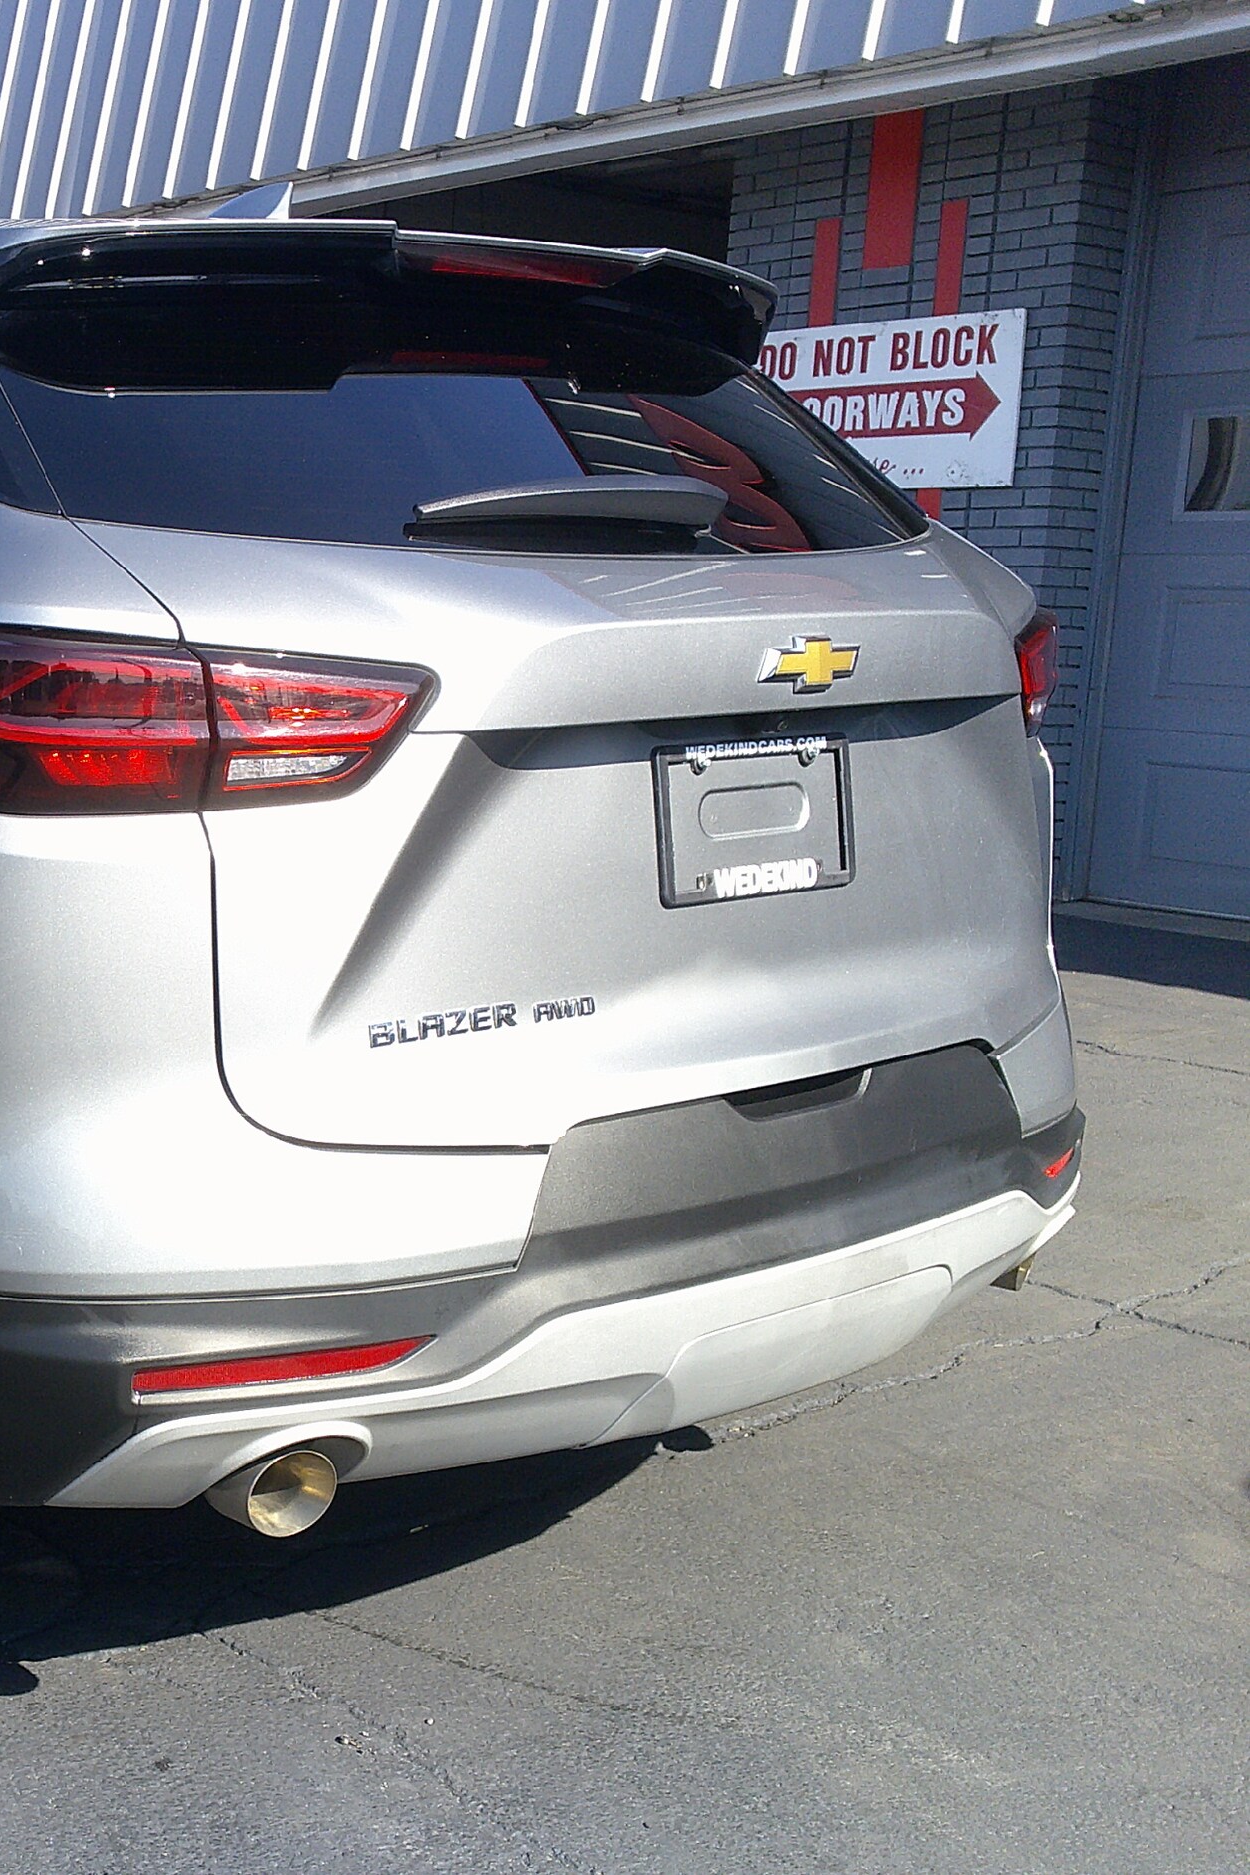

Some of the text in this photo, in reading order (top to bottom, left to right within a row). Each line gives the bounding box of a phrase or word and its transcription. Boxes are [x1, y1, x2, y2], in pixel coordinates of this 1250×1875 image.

[759, 322, 1000, 381] DO NOT BLOCK
[803, 387, 966, 434] ORWAYS
[685, 735, 828, 760] WEDEKINDCARS.COM
[713, 856, 818, 899] WEDEKIND
[367, 996, 596, 1049] BLAZER AWD
